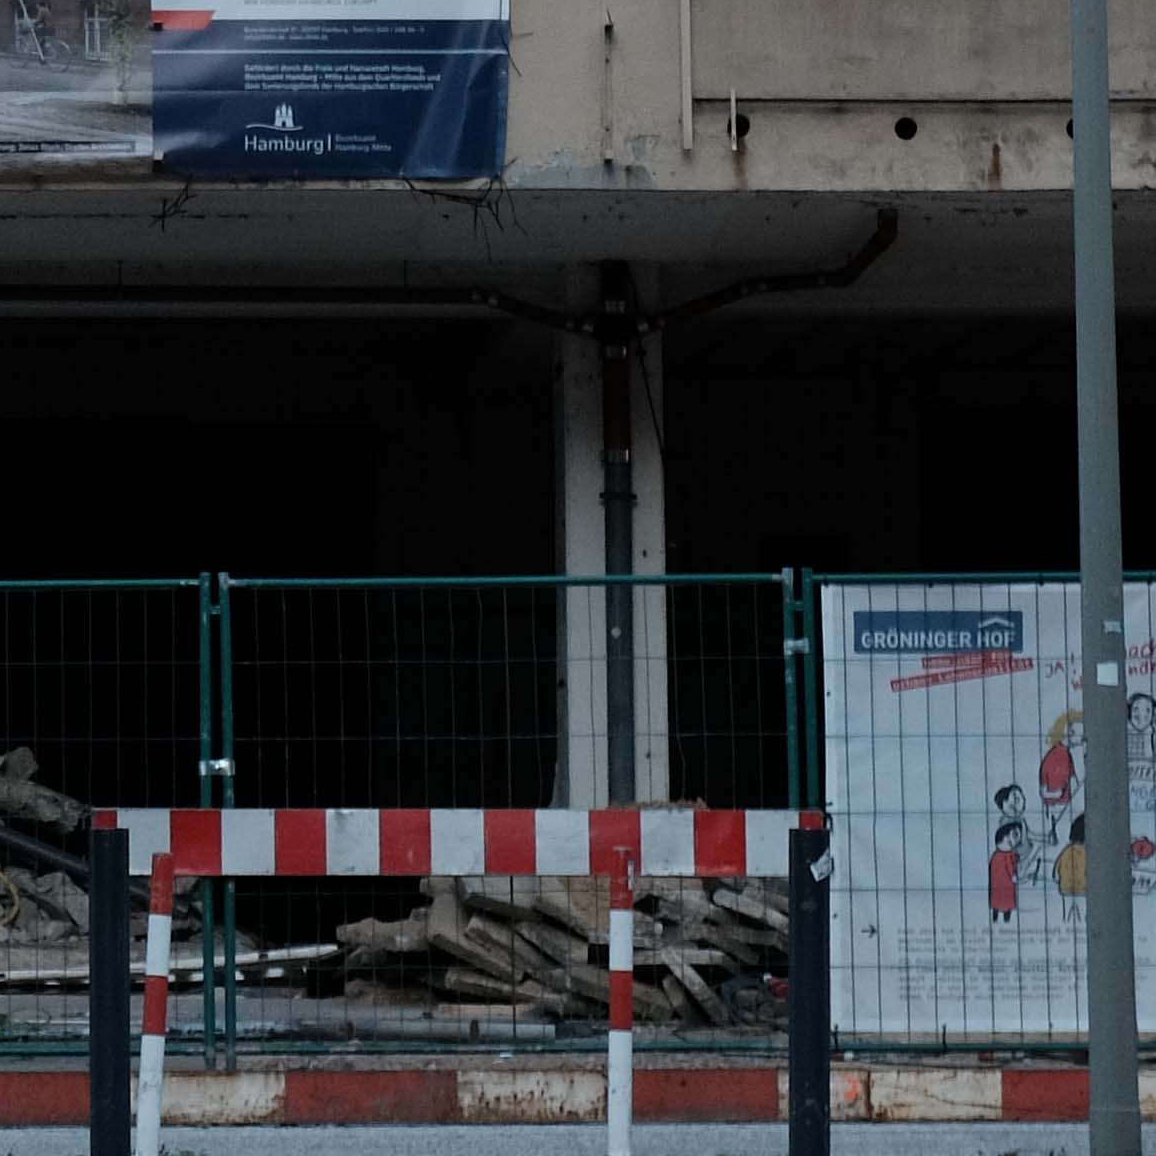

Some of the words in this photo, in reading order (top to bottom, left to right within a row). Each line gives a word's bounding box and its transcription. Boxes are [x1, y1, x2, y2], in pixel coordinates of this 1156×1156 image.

[244, 134, 324, 155] Hamburg
[861, 628, 972, 650] GRÖNINGER
[976, 630, 1016, 649] HOF
